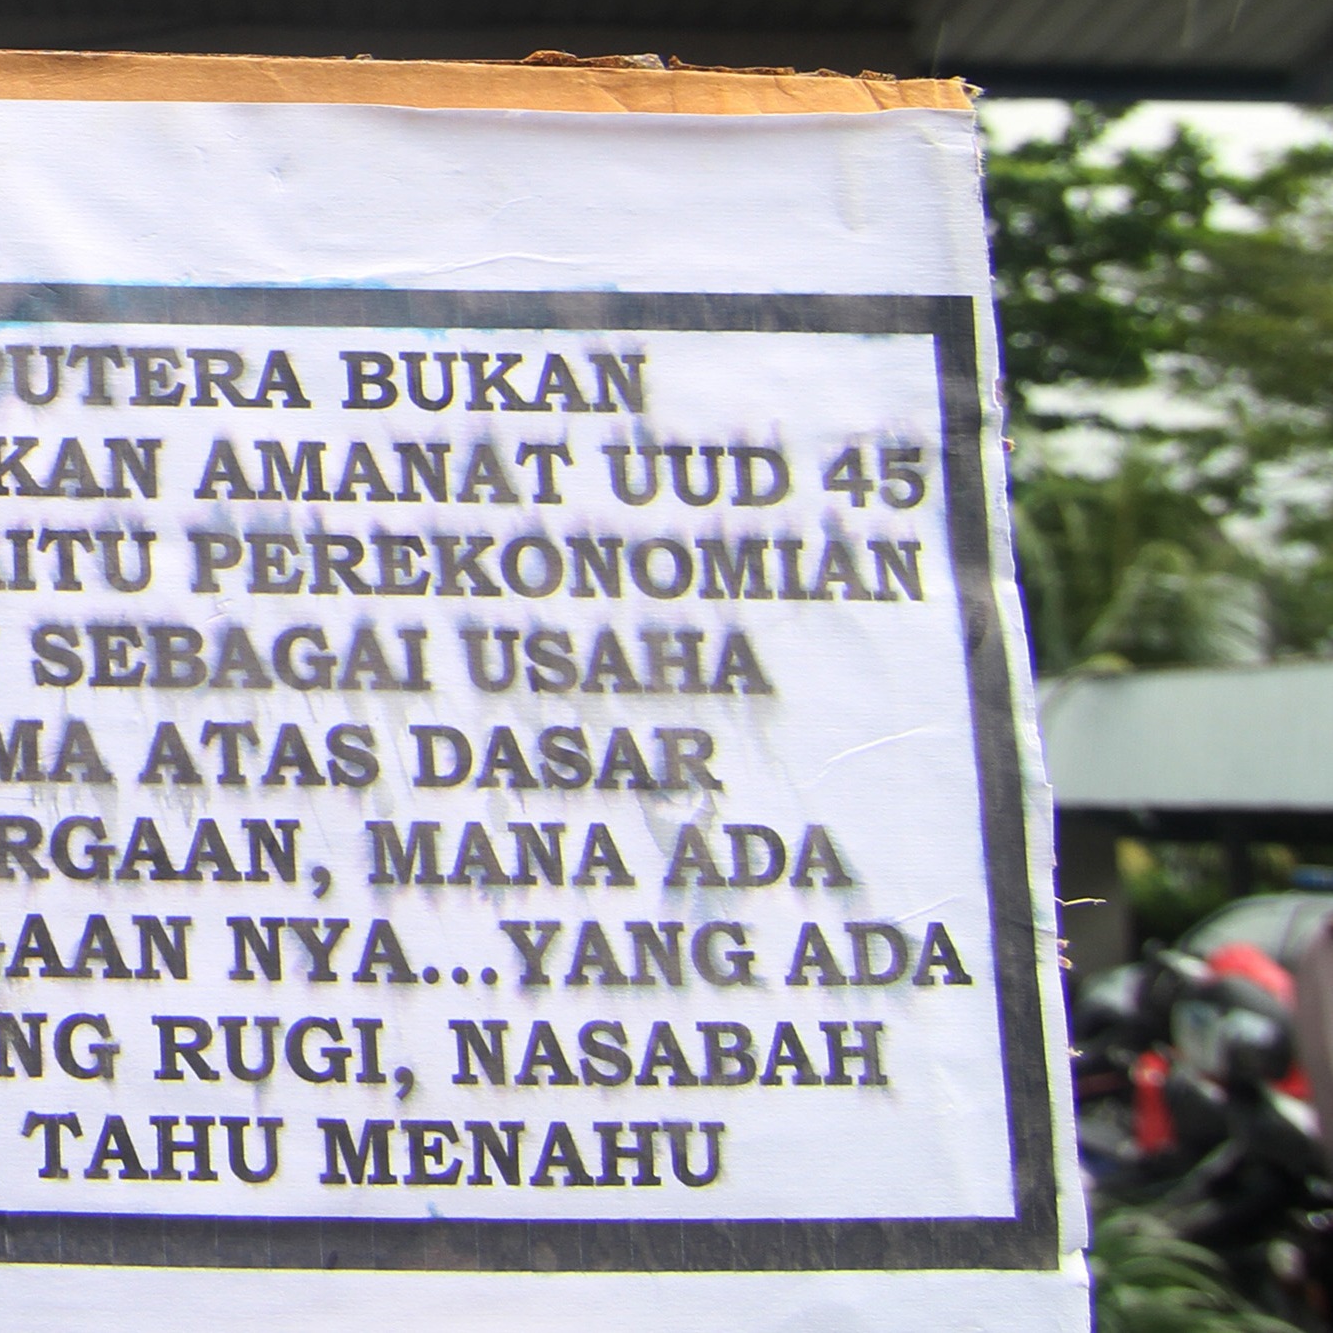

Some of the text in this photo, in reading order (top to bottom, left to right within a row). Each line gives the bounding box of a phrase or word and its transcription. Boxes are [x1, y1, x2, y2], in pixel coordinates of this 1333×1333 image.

[341, 351, 646, 414] BUKAN
[194, 441, 573, 505] AMANAT
[605, 445, 790, 507] UUD
[820, 447, 930, 513] 45
[187, 531, 922, 601] PEREKONOMIAN
[31, 623, 433, 695] SEBAGAI
[466, 630, 772, 694] USAHA
[139, 721, 380, 789] ATAS
[410, 725, 723, 793] DASAR
[366, 821, 634, 887] MANA
[664, 825, 854, 889] ADA
[786, 922, 974, 987] ADA
[151, 1015, 415, 1102] RUGI,
[449, 1020, 889, 1088] NASABAH
[21, 1111, 285, 1185] TAHU
[317, 1118, 726, 1189] MENAHU
